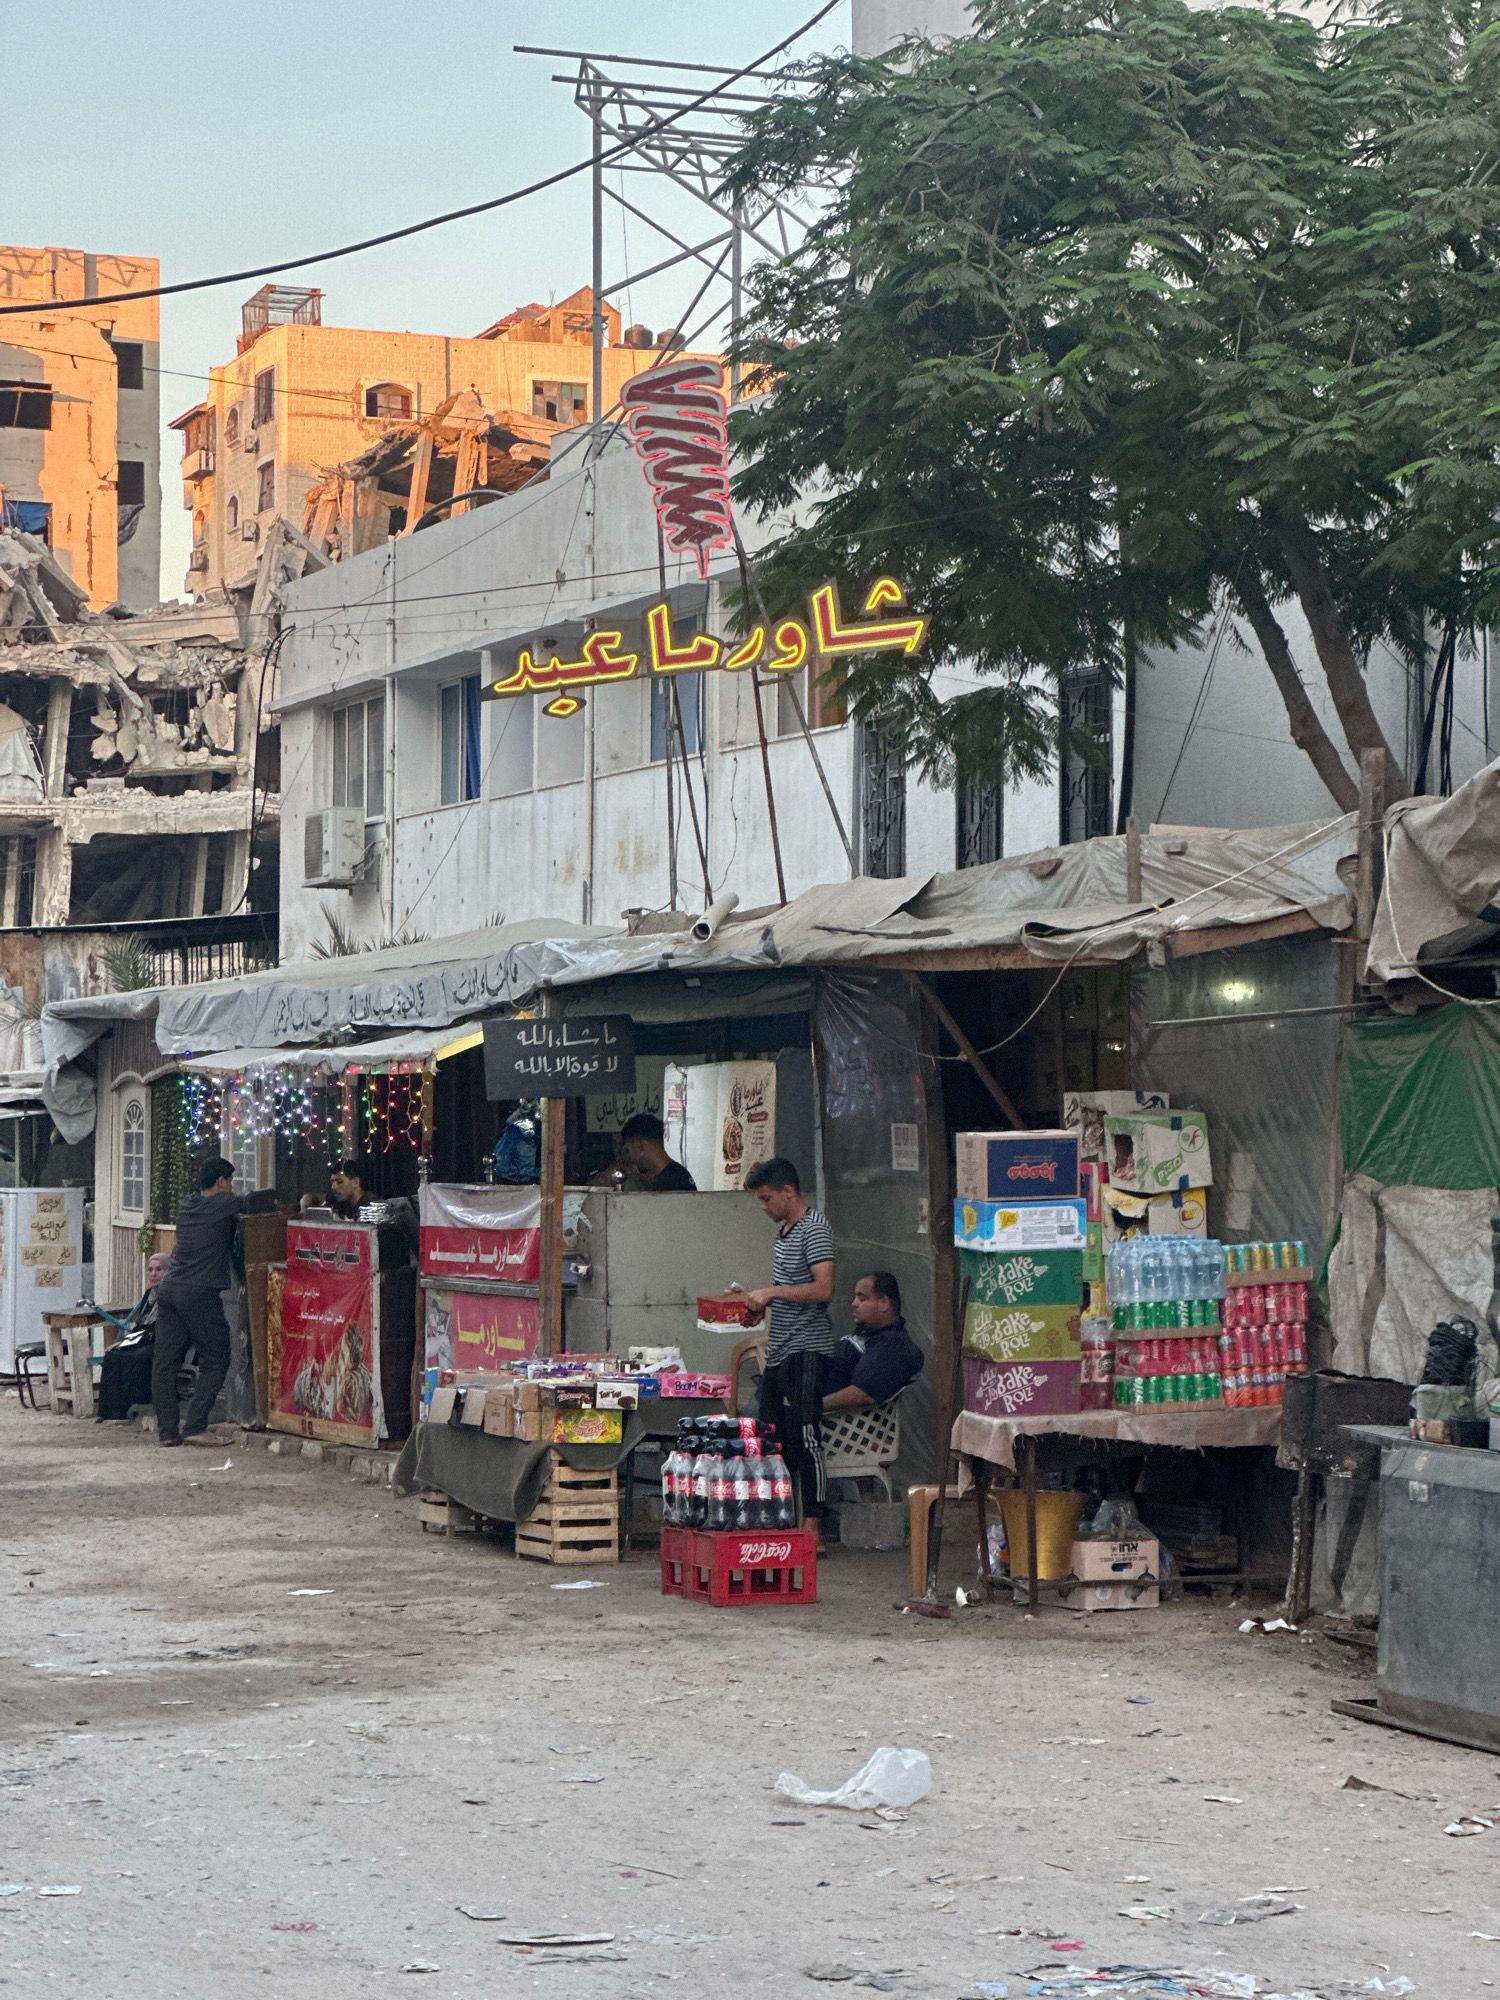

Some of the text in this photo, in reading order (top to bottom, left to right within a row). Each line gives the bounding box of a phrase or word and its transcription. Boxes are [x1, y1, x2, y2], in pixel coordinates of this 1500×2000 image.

[494, 575, 926, 718] شاورما عبد
[517, 1024, 553, 1048] الله
[515, 1056, 555, 1075] بالله
[572, 1053, 600, 1079] قوة
[606, 1056, 618, 1074] لا
[477, 1235, 528, 1272] شاورما
[457, 1307, 526, 1357] شاورما
